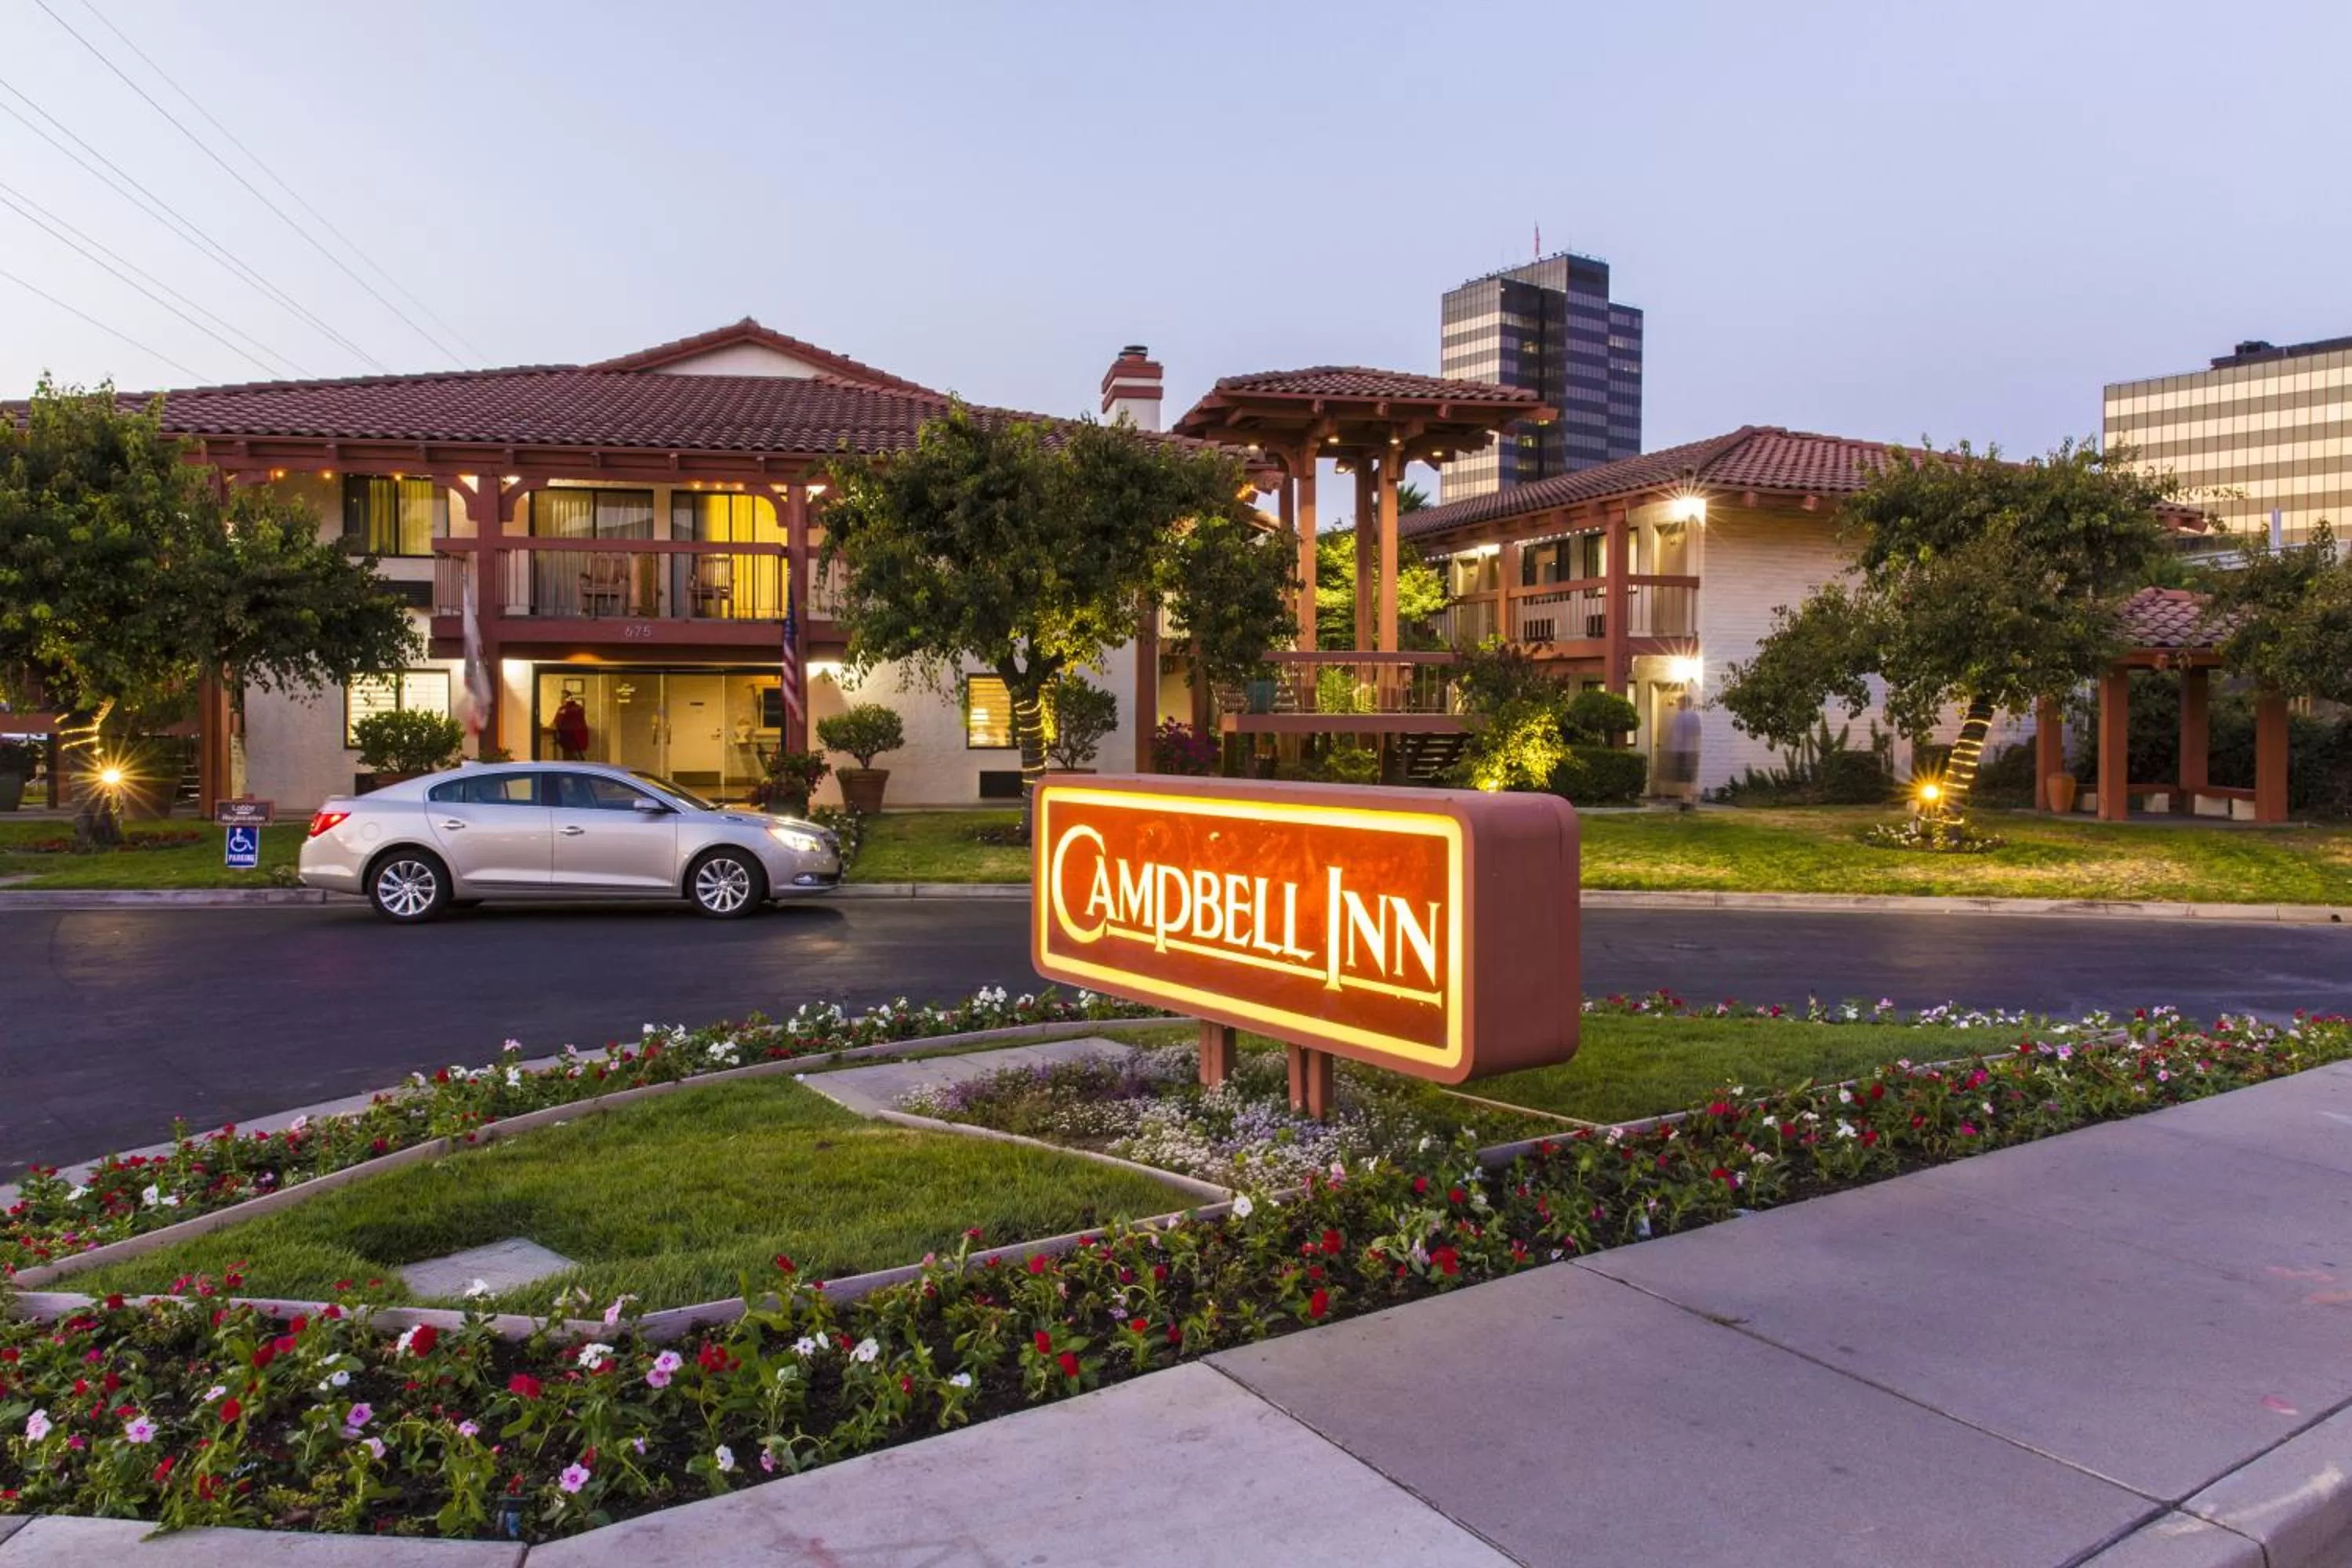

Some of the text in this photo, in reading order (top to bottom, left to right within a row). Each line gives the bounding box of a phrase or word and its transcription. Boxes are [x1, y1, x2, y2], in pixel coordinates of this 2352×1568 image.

[228, 854, 255, 862] PARKING
[1051, 824, 1441, 991] CAMPBELL INN
